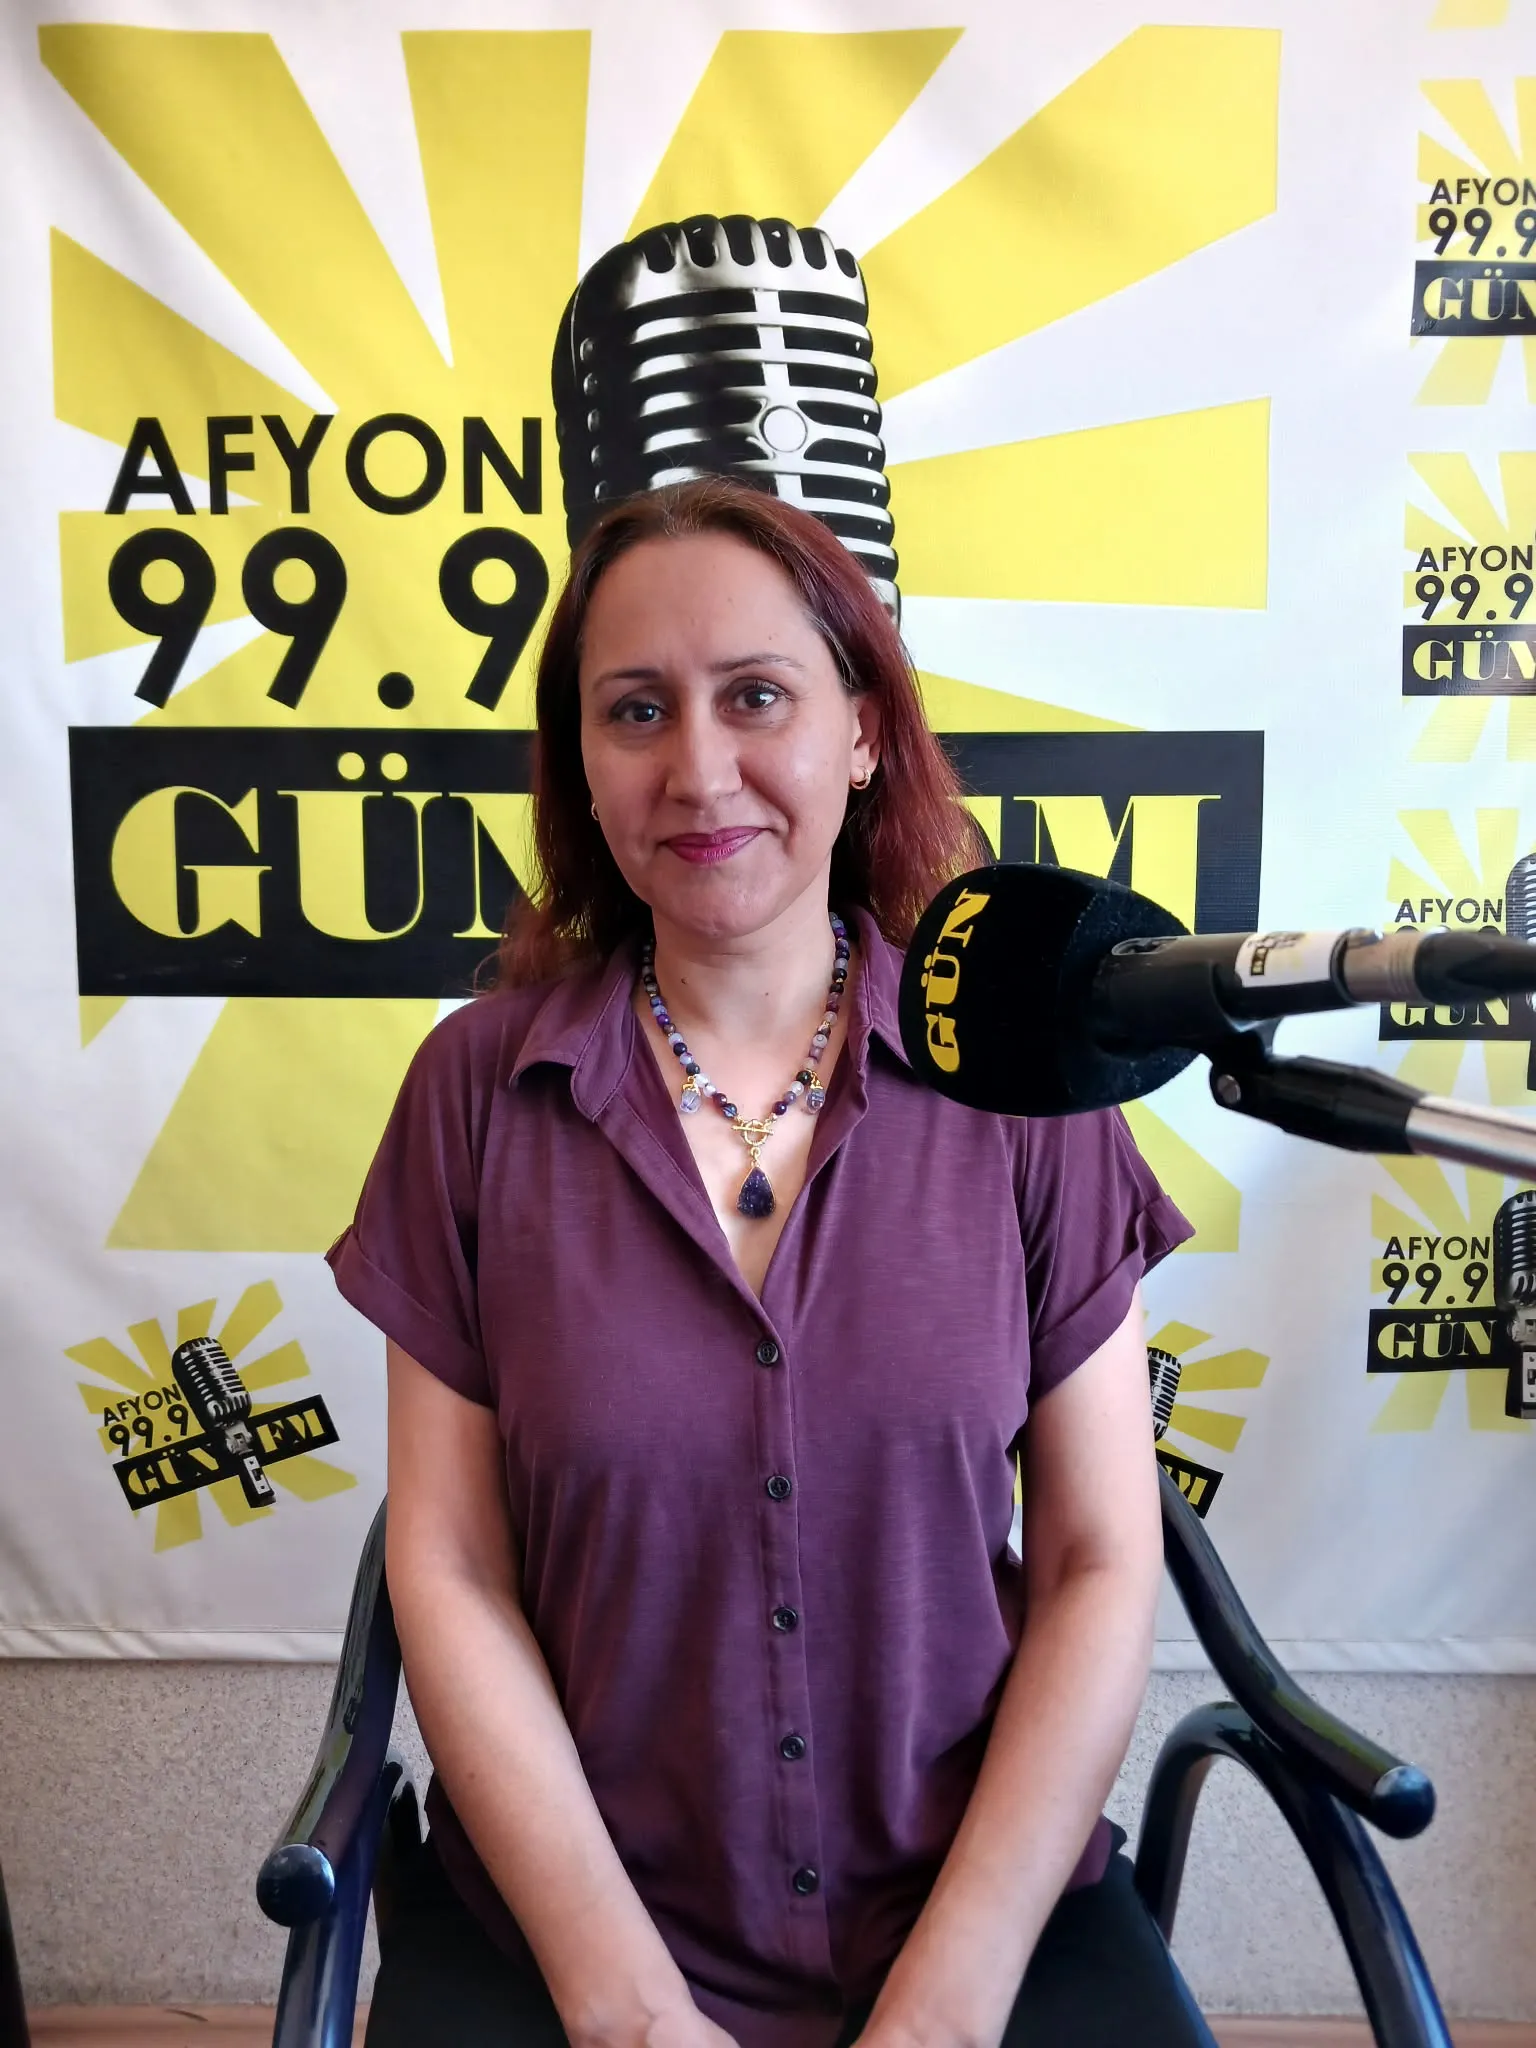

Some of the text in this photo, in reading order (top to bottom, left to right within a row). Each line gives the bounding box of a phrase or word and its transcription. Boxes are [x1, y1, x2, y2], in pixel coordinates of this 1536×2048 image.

[104, 413, 542, 515] AFYON
[1415, 545, 1533, 573] AFYON
[108, 526, 550, 713] 99.9
[1415, 573, 1534, 621] 99.9
[1412, 630, 1536, 681] GÜN
[111, 751, 1222, 941] GÜN M
[1394, 898, 1503, 923] AFYON
[920, 887, 991, 1073] GÜN
[1382, 1236, 1491, 1261] AFYON
[1382, 1262, 1489, 1305] 99.9
[1377, 1313, 1497, 1360] GÜN
[103, 1384, 182, 1427] AFYON
[108, 1403, 189, 1457] 99.9
[128, 1408, 325, 1496] GÜN FM
